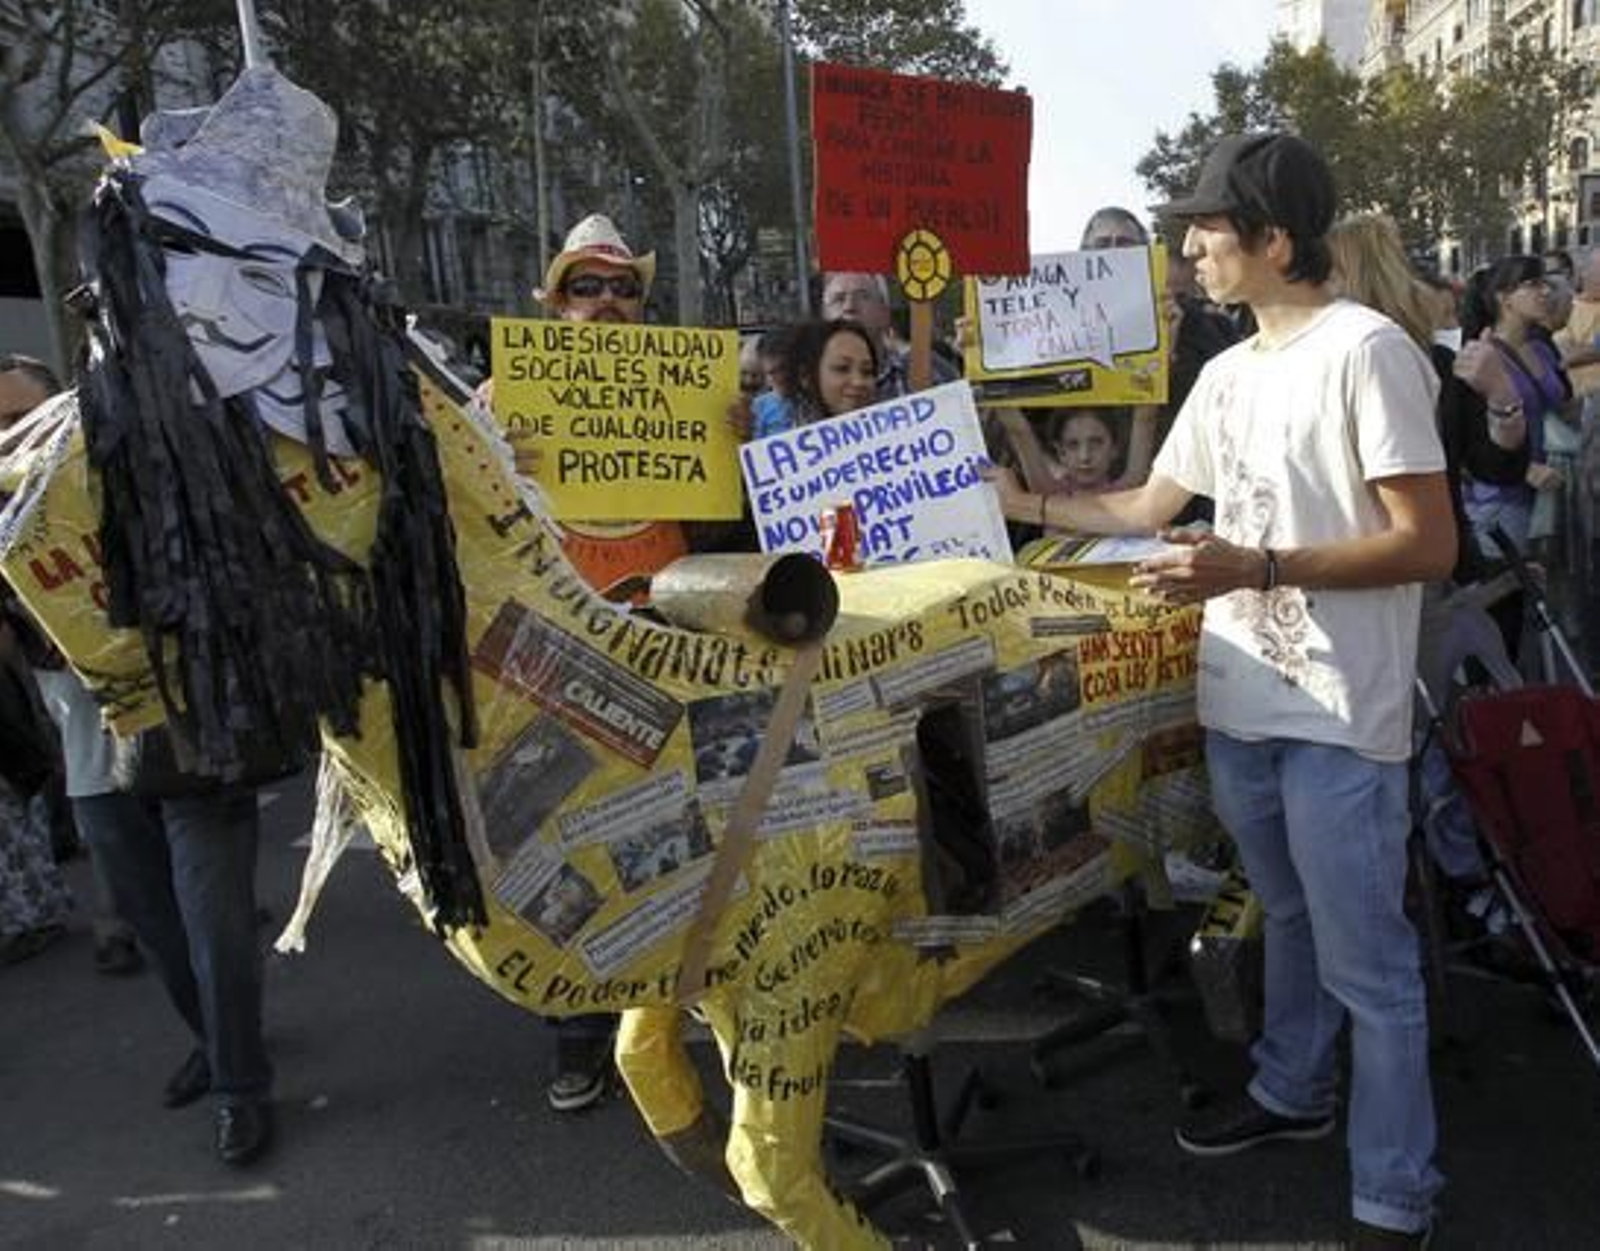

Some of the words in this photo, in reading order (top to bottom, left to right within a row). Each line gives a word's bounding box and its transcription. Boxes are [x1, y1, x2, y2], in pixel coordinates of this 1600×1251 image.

[503, 326, 536, 350] LA
[508, 355, 607, 383] SOCIAL
[613, 358, 648, 384] ES
[569, 415, 708, 444] CUALQUIER
[743, 438, 800, 490] LA
[796, 396, 937, 467] SANIDAD
[558, 448, 707, 485] PROTESTA
[757, 487, 787, 515] ES
[789, 476, 823, 502] UN
[822, 427, 957, 490] DERECHO
